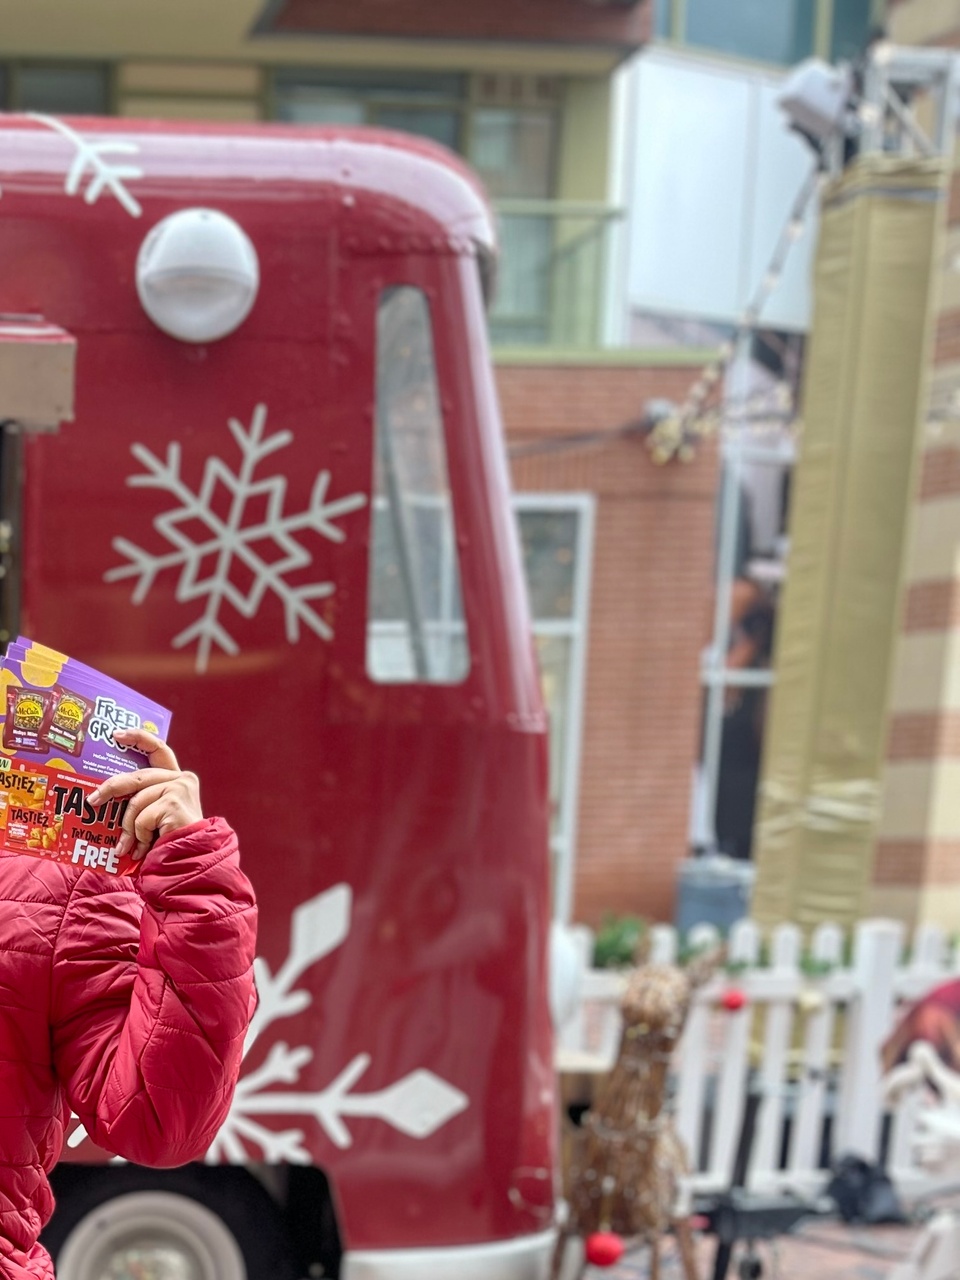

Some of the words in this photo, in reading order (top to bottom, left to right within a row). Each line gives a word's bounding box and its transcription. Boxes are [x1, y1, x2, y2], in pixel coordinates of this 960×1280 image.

[71, 828, 86, 839] TRY
[85, 831, 103, 844] ONE
[104, 836, 118, 846] ON
[71, 838, 120, 874] FREE
